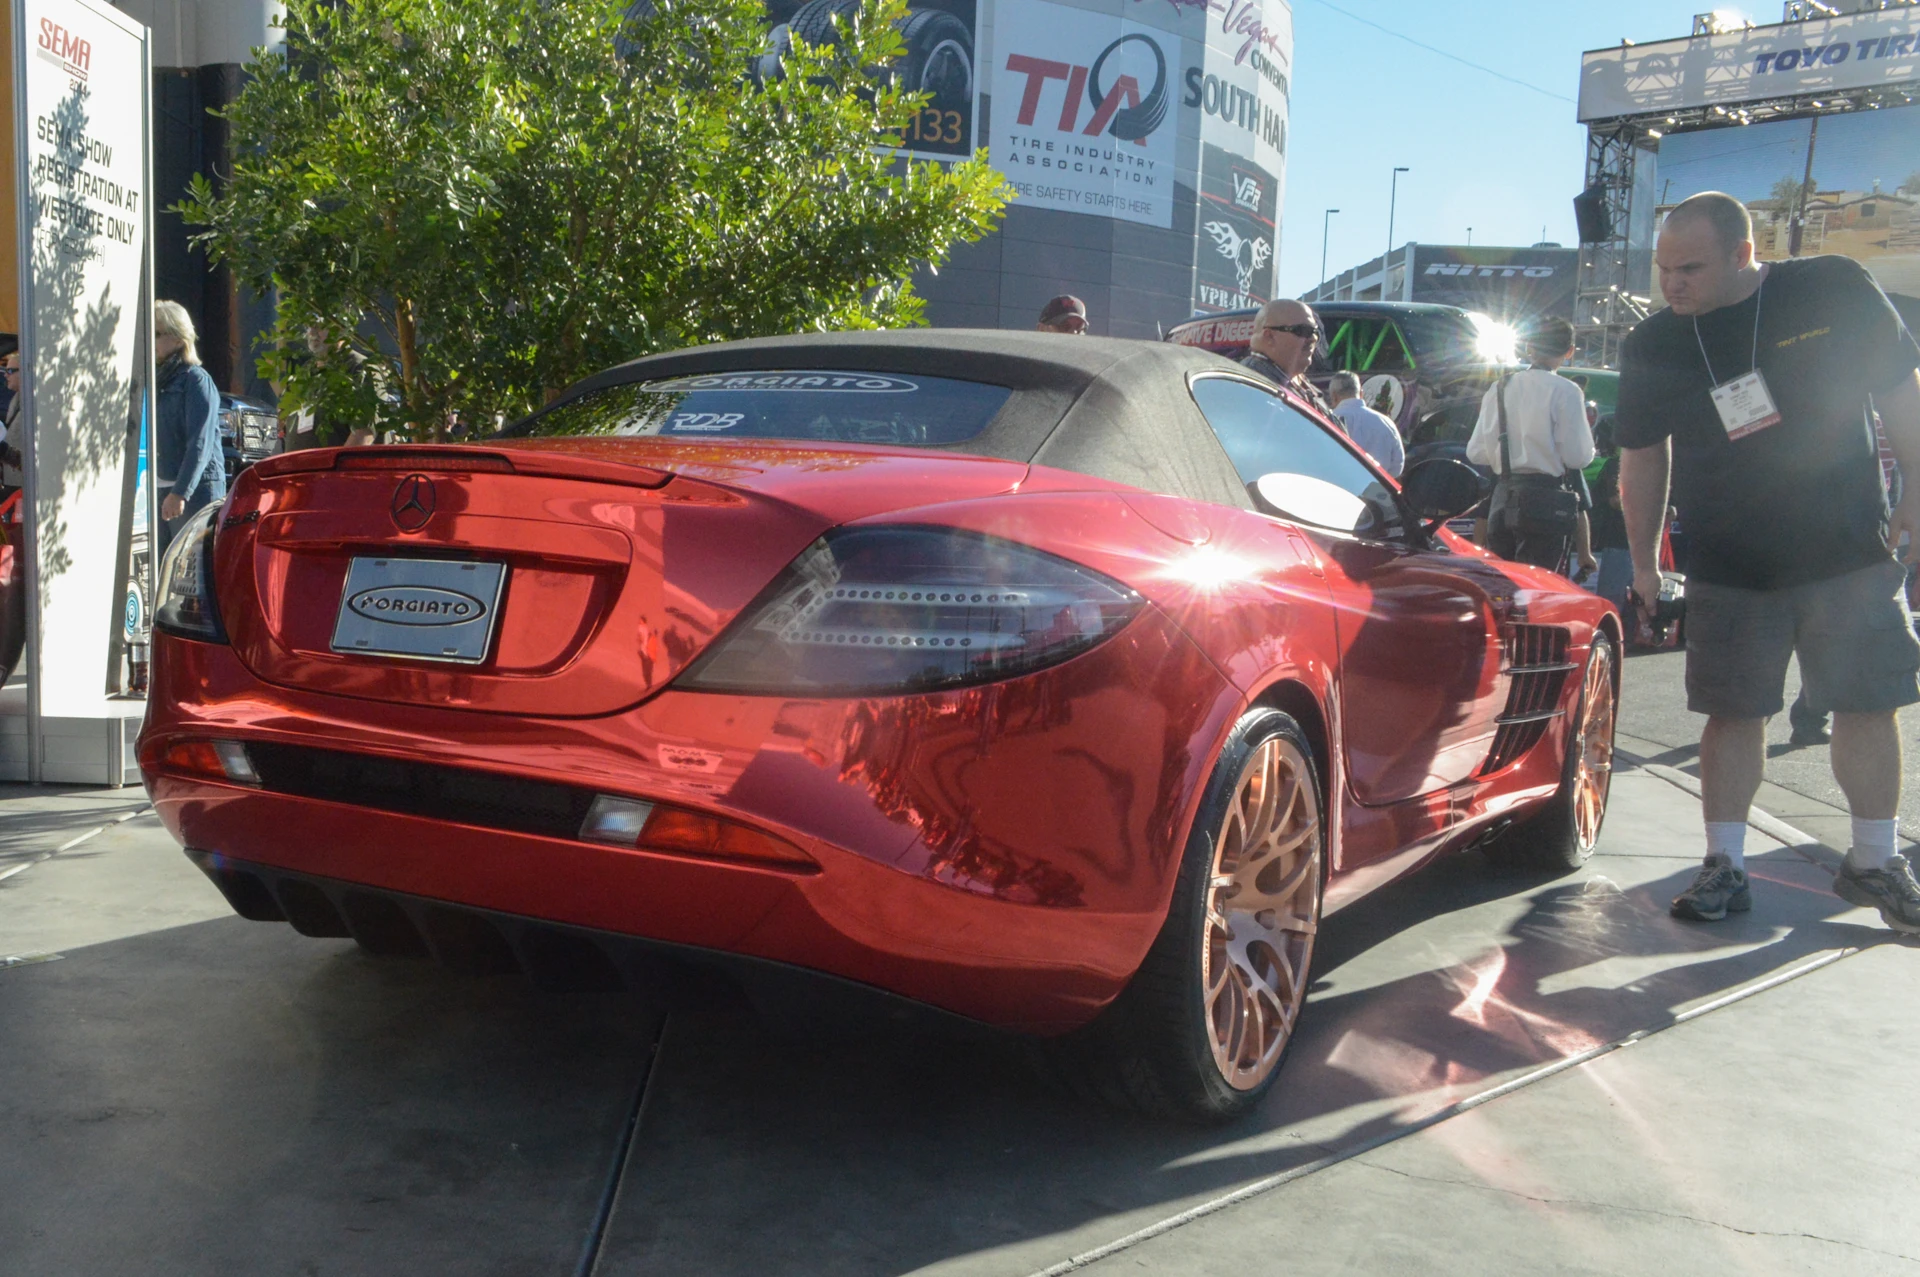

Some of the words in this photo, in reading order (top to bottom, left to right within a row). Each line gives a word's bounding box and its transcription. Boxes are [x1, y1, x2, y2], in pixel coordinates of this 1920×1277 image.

[38, 16, 92, 71] SEMA
[1755, 42, 1851, 74] TOYO
[1006, 53, 1148, 147] TIA
[1184, 66, 1261, 136] SOUTH
[37, 115, 72, 153] SEMA
[77, 136, 112, 168] SHOW
[1010, 135, 1054, 151] TIRE
[1066, 144, 1155, 170] INDUSTRY
[38, 153, 123, 206] REGISTRATION
[125, 191, 139, 213] AT
[1009, 153, 1154, 186] ASSOCIATION
[1007, 181, 1033, 196] TIRE
[1036, 185, 1082, 203] SAFETY
[1084, 192, 1126, 209] STARTS
[1233, 172, 1262, 207] VPR
[38, 191, 103, 237] WESTGATE
[107, 216, 135, 245] ONLY
[1424, 263, 1554, 278] NITTO
[1215, 320, 1255, 342] DIGGE
[659, 375, 894, 390] FORGIATO
[361, 596, 471, 616] FORGIATO
